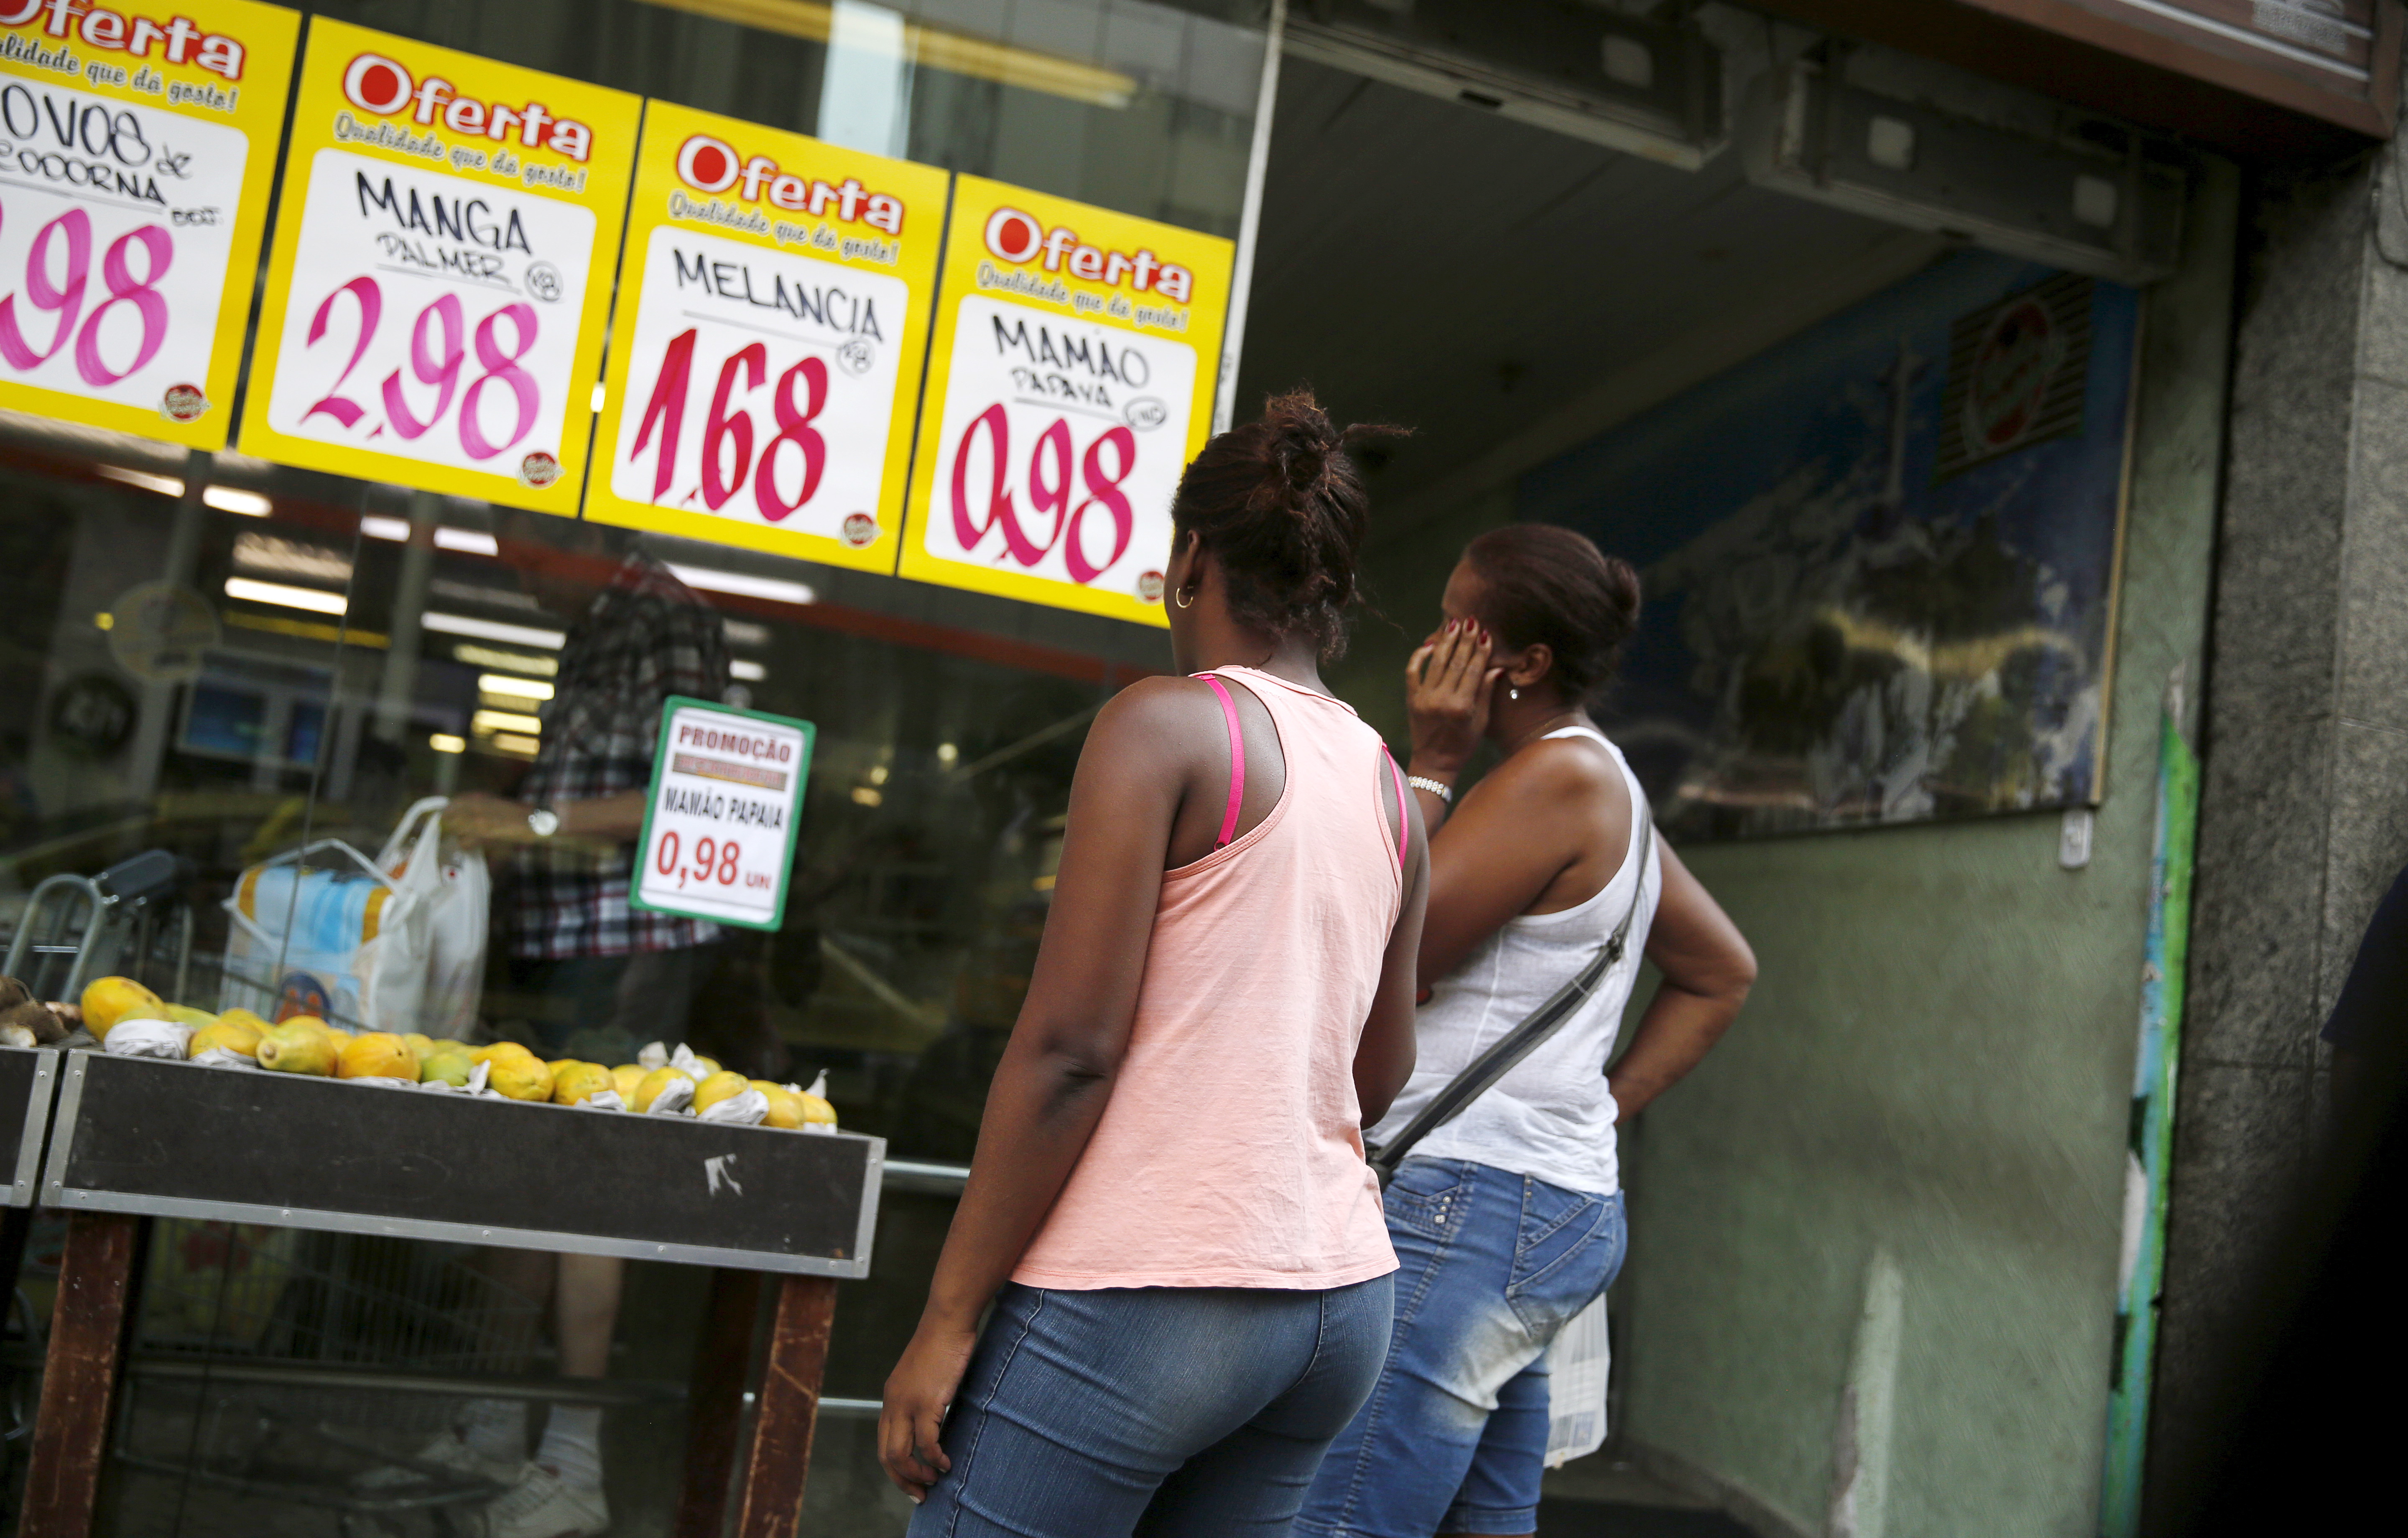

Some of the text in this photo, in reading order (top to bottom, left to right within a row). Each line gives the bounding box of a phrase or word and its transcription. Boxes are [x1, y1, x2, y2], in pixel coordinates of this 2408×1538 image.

[0, 0, 244, 79] ferta
[0, 33, 237, 112] lidade que dá gosto!
[343, 53, 592, 162] Oferta
[335, 112, 586, 193] Qualidade que dá gosto!
[676, 134, 905, 235] Oferta
[356, 171, 533, 254] MANGA
[669, 192, 770, 236] Qualidade
[775, 222, 808, 245] que
[841, 237, 900, 265] gosto!
[377, 232, 513, 287] PALMER
[673, 247, 883, 343] MELANCIA
[985, 207, 1193, 303] Oferta
[977, 260, 1069, 305] Qualidade
[1073, 288, 1104, 313] que
[1135, 304, 1188, 333] gosto!
[298, 276, 540, 460] 2,98
[1010, 367, 1113, 409] PAPAYA
[630, 328, 828, 522] 1,68
[951, 402, 1136, 585] 0,98
[679, 726, 790, 763] PROMOÇÃO
[658, 831, 740, 889] 0,98
